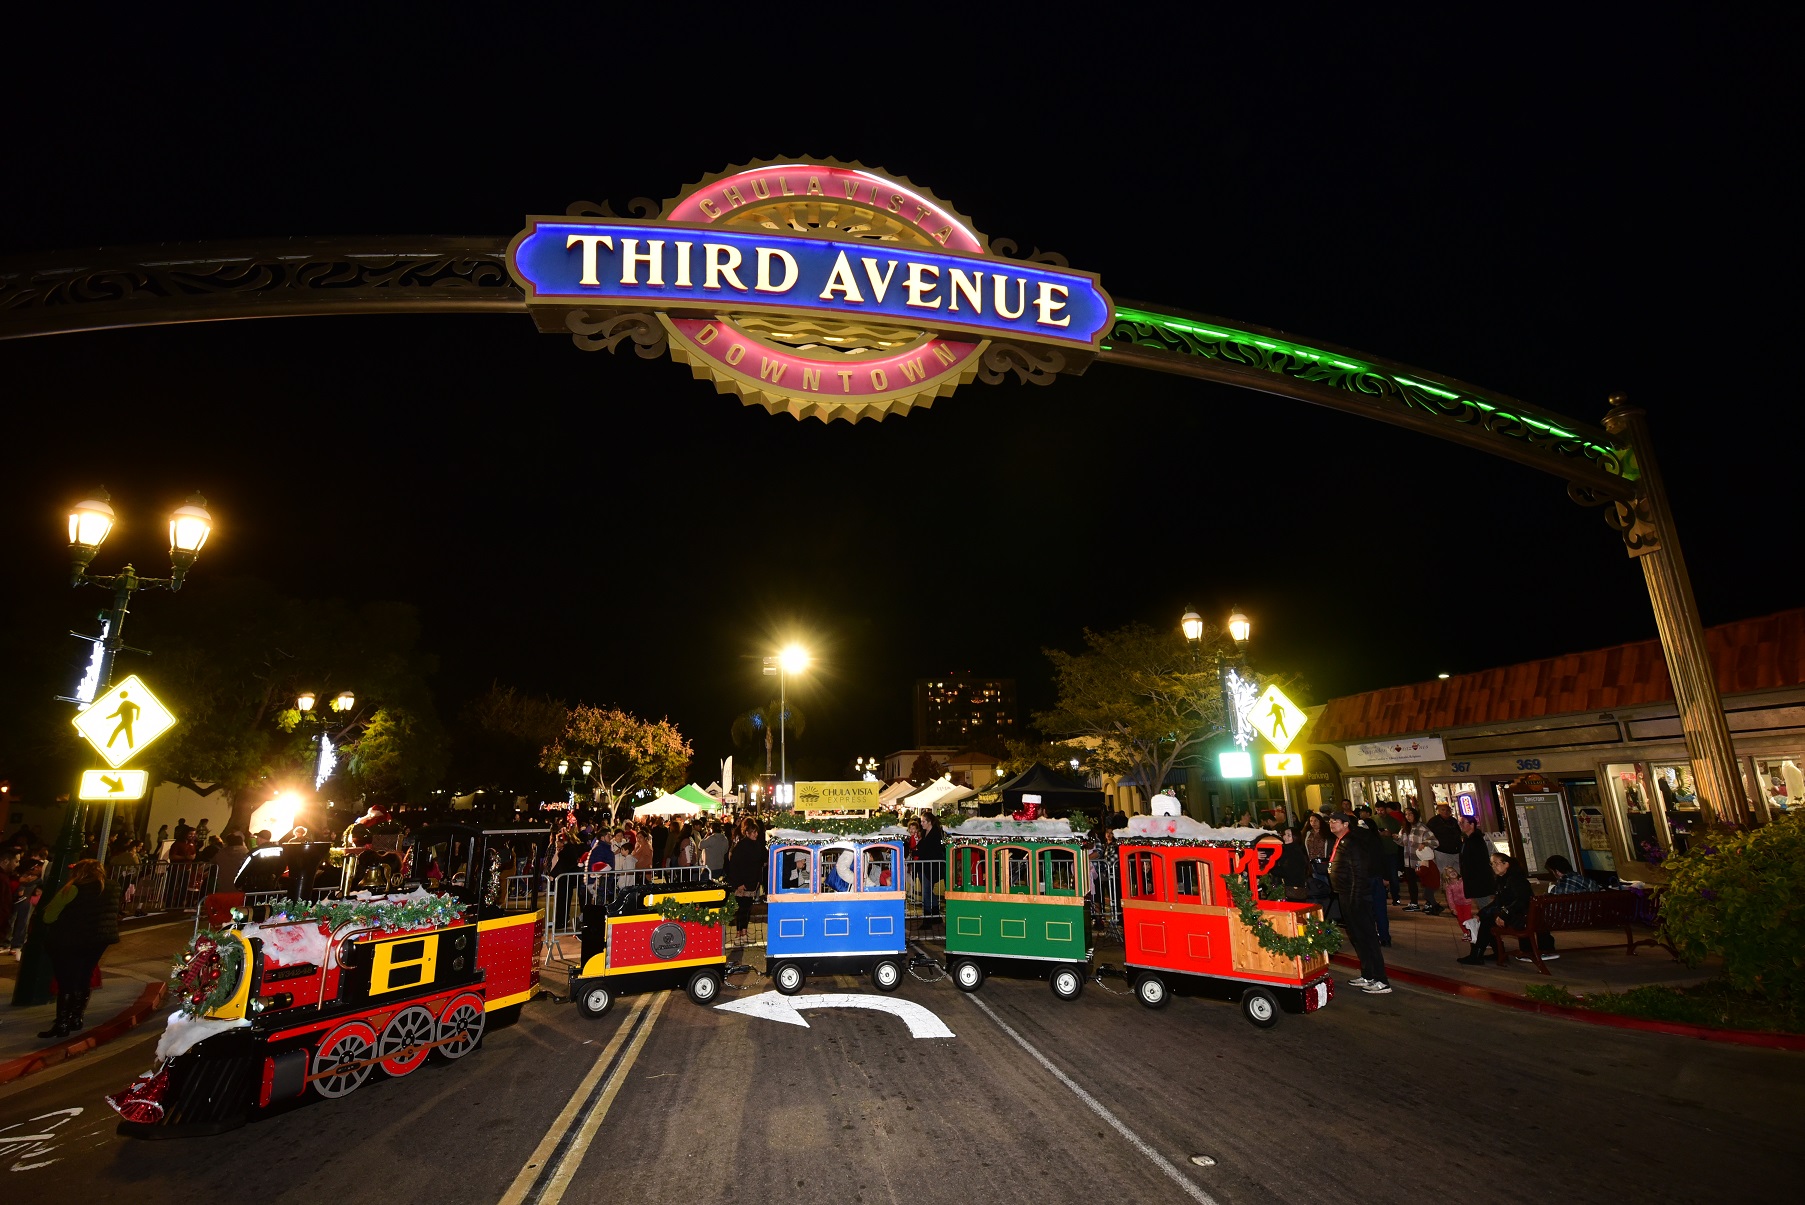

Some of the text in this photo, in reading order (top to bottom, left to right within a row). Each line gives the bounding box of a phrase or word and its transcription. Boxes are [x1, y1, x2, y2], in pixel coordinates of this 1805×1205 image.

[699, 174, 954, 247] CHULA VISTA
[565, 233, 1072, 328] THIRD AVENUE
[693, 322, 957, 393] DOWNTOWN
[1307, 772, 1329, 780] Parking
[1451, 759, 1540, 772] 367 369
[852, 788, 873, 796] VISTA
